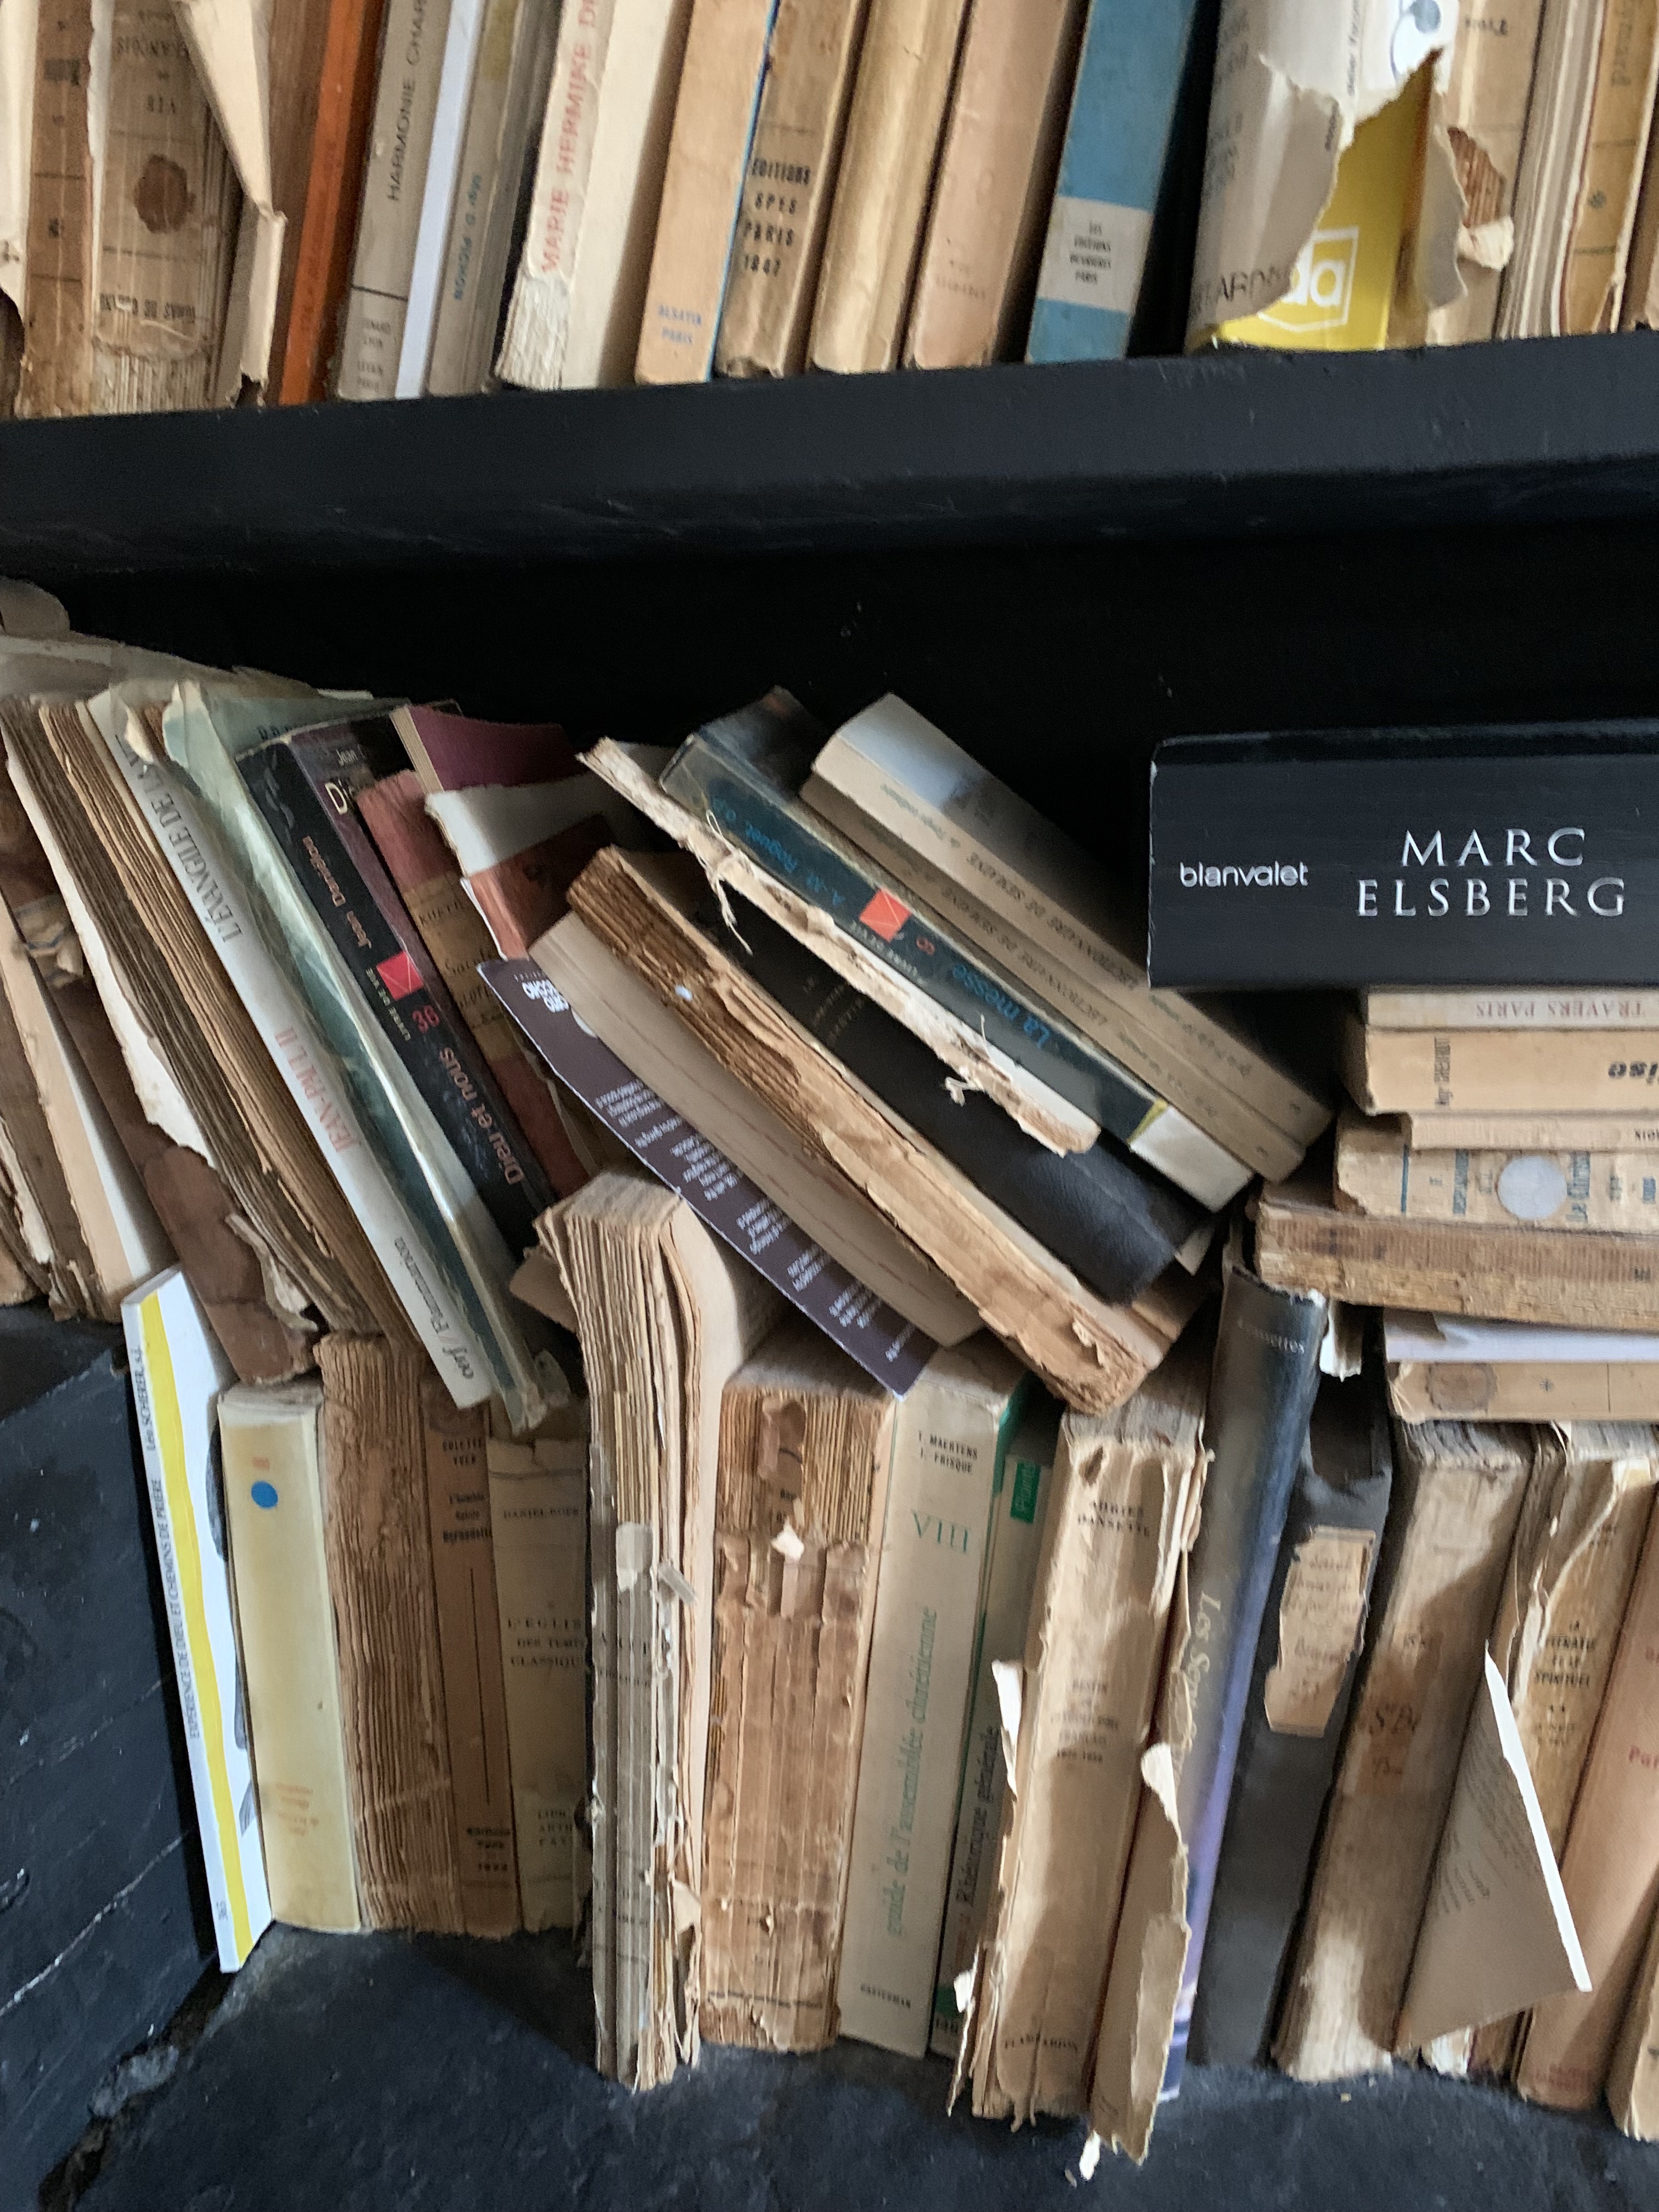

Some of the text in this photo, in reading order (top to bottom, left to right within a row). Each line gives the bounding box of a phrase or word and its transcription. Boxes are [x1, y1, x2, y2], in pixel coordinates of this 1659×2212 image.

[387, 76, 416, 202] HARMONIE
[743, 221, 794, 247] PARIS
[151, 794, 180, 827] DE
[1401, 827, 1585, 867] MARC
[1180, 861, 1308, 888] blanvalet
[1357, 877, 1625, 917] ELSBERG
[345, 911, 372, 948] Jean
[951, 963, 1049, 1048] La messe
[1476, 1000, 1646, 1019] TRAVERS PARIS
[439, 1047, 477, 1102] nous
[470, 1104, 493, 1130] et
[488, 1130, 525, 1185] Dieu
[394, 1236, 449, 1334] Flammarion
[913, 1510, 969, 1554] VIII
